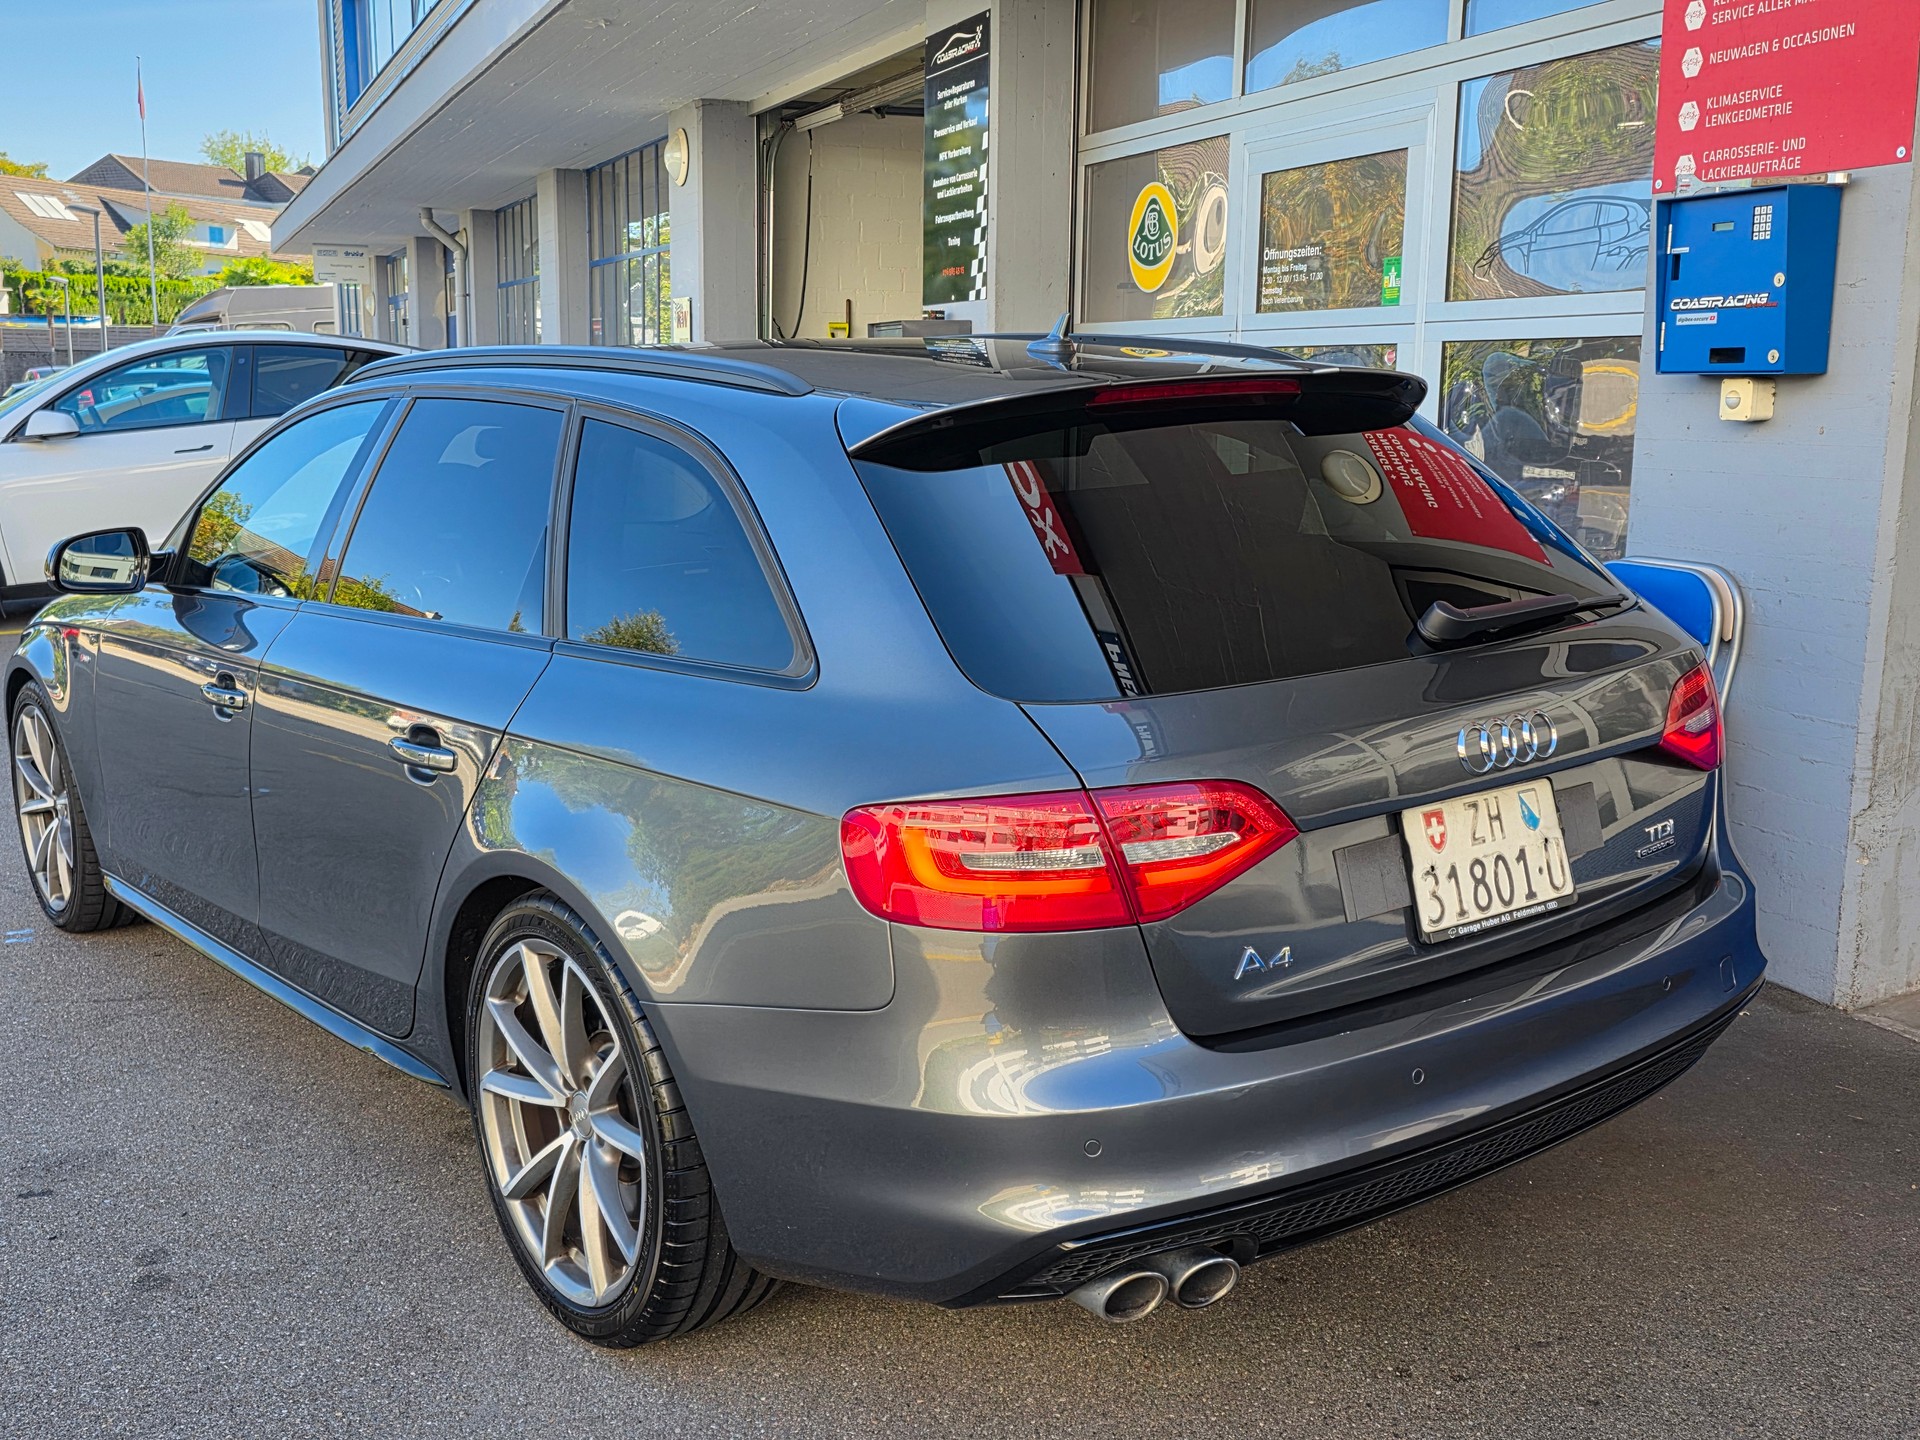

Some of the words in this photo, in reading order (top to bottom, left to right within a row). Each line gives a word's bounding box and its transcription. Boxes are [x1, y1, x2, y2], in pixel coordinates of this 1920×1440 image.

[1711, 4, 1755, 25] SERVICE
[1757, 0, 1792, 15] ALLER
[1709, 40, 1769, 65] NEUWAGEN
[1772, 37, 1780, 51] &
[1782, 22, 1856, 50] OCCASIONEN
[1706, 84, 1783, 110] KLIMASERVICE
[1705, 101, 1793, 128] LENKGEOMETRIE
[1702, 141, 1779, 163] CARROSSERIE-
[1782, 136, 1806, 152] UND
[1701, 155, 1802, 181] LACKIERAUFTRÄGE
[1134, 232, 1171, 260] LOTUS
[1264, 245, 1322, 261] Öffnungszeiten:
[1263, 266, 1280, 274] Montag
[1670, 292, 1769, 311] COASTRACING
[1463, 796, 1506, 847] ZH
[1645, 819, 1674, 842] TDI
[1641, 838, 1675, 856] quattro
[1458, 924, 1481, 935] Garage
[1482, 917, 1500, 928] Huber
[1501, 912, 1511, 922] AG
[1233, 945, 1294, 980] A4
